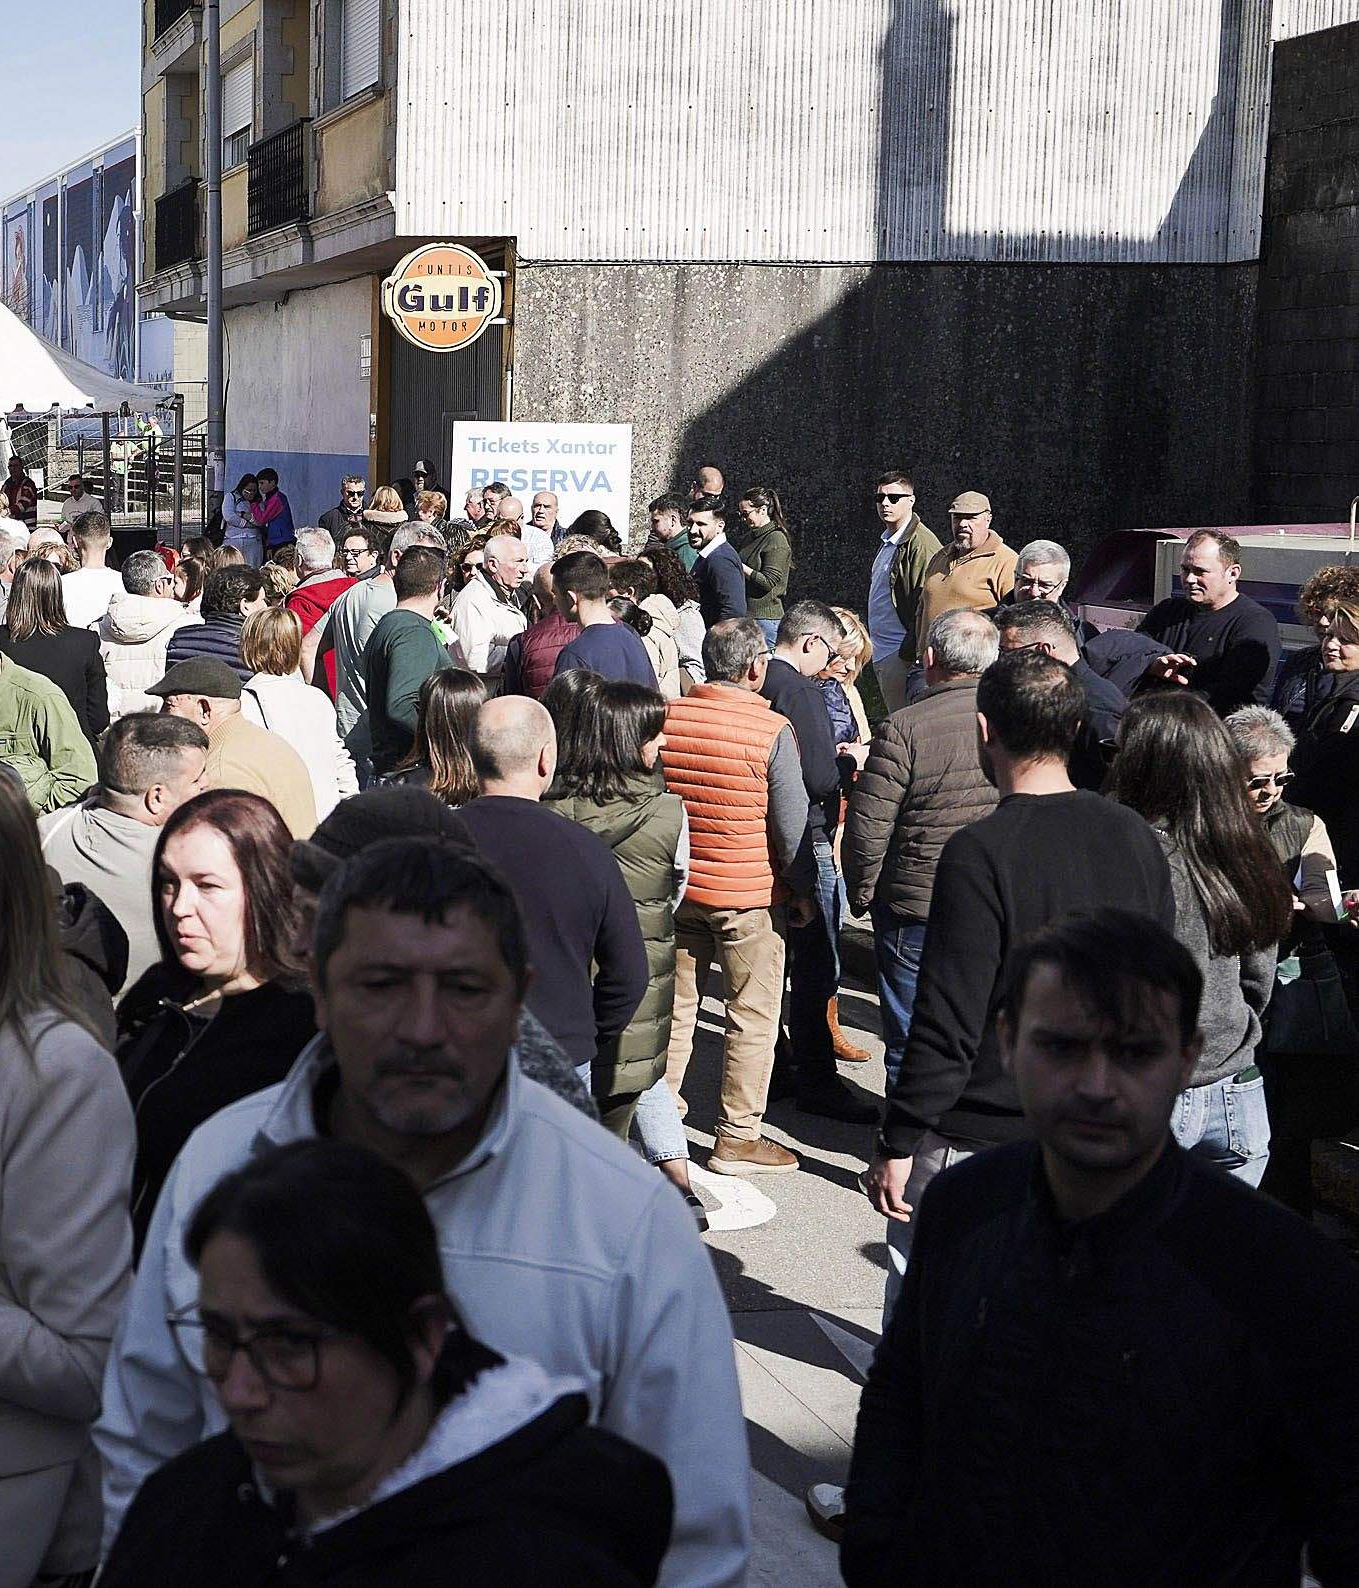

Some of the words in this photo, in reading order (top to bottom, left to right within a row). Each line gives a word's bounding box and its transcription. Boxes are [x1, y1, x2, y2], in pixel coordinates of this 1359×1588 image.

[398, 284, 490, 312] Gulf
[418, 321, 467, 332] MOTOR
[468, 437, 540, 454] Tickets
[546, 438, 617, 455] Xantar
[471, 468, 613, 493] RESERVA
